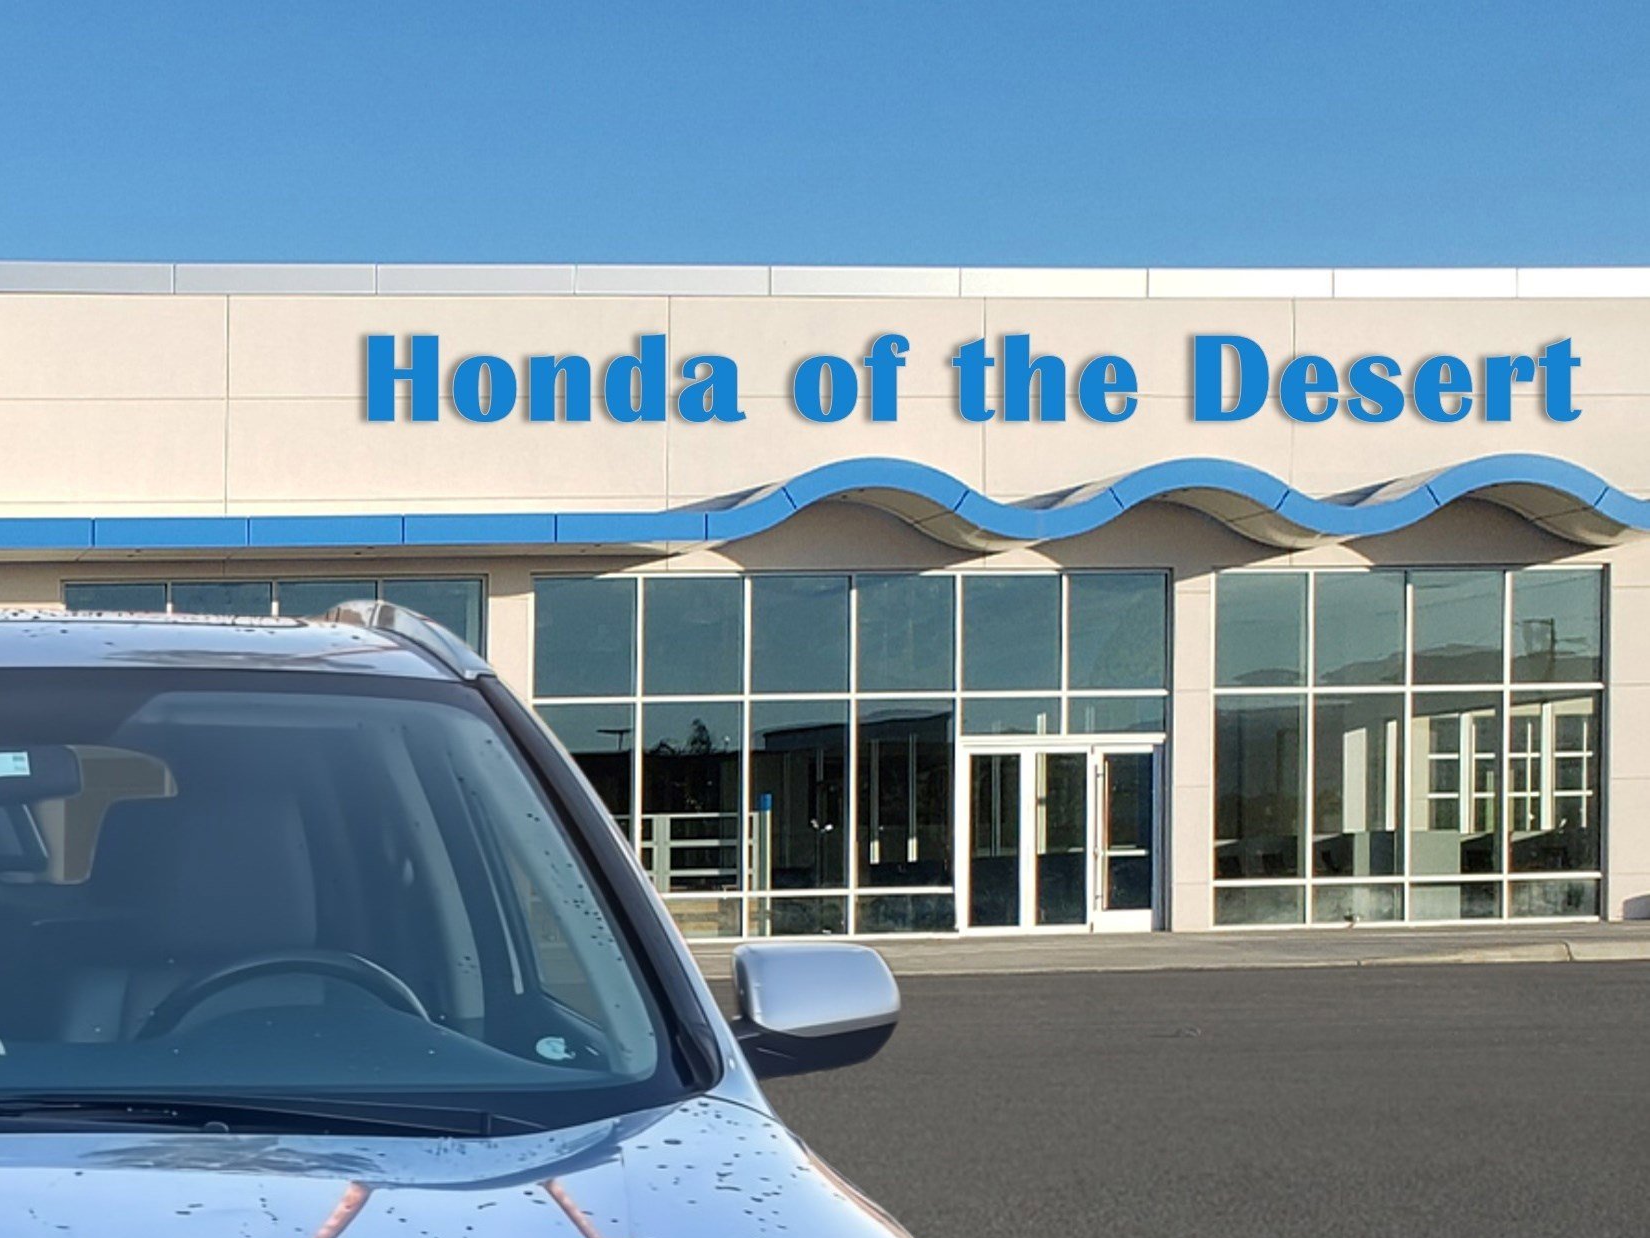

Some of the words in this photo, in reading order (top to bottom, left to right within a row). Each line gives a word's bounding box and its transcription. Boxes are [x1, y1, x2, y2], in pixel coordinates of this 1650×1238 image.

[365, 333, 747, 424] Honda
[792, 333, 911, 424] of
[952, 333, 1140, 424] the
[1193, 333, 1583, 424] Desert
